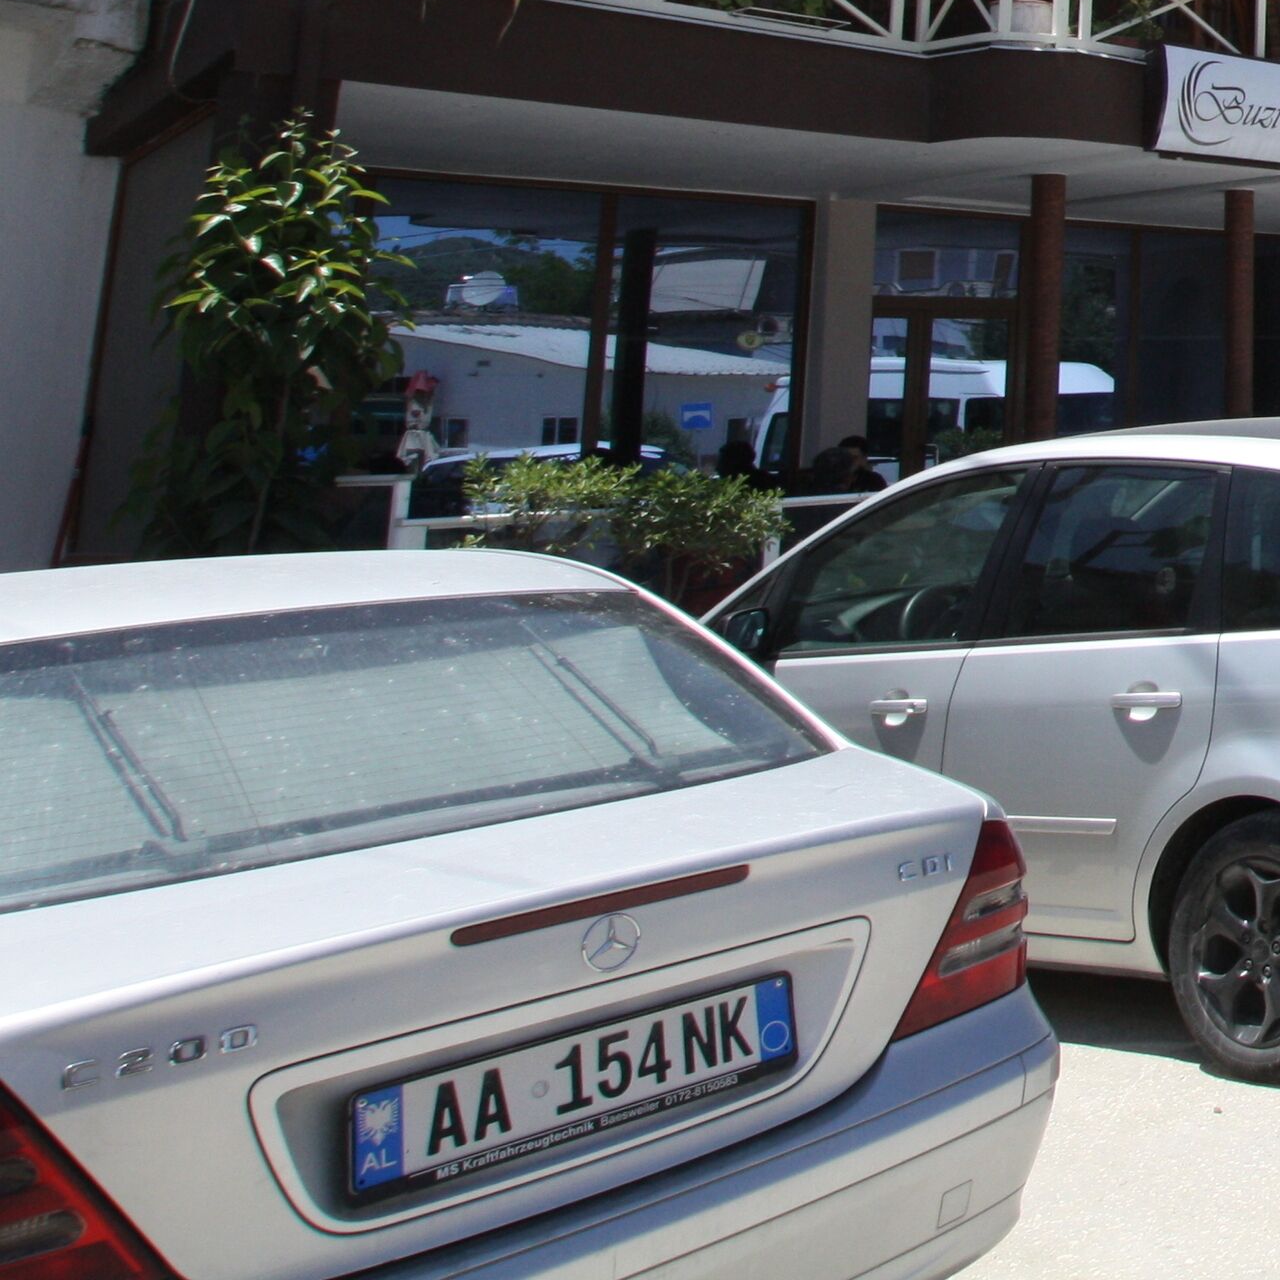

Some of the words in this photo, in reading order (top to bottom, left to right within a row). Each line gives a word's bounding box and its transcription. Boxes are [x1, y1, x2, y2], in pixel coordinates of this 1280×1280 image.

[897, 851, 956, 882] CDI
[426, 1067, 513, 1157] AA
[360, 1148, 398, 1176] AL
[435, 1162, 460, 1181] MS
[462, 1119, 595, 1171] Kraftfahrzeugtechnik
